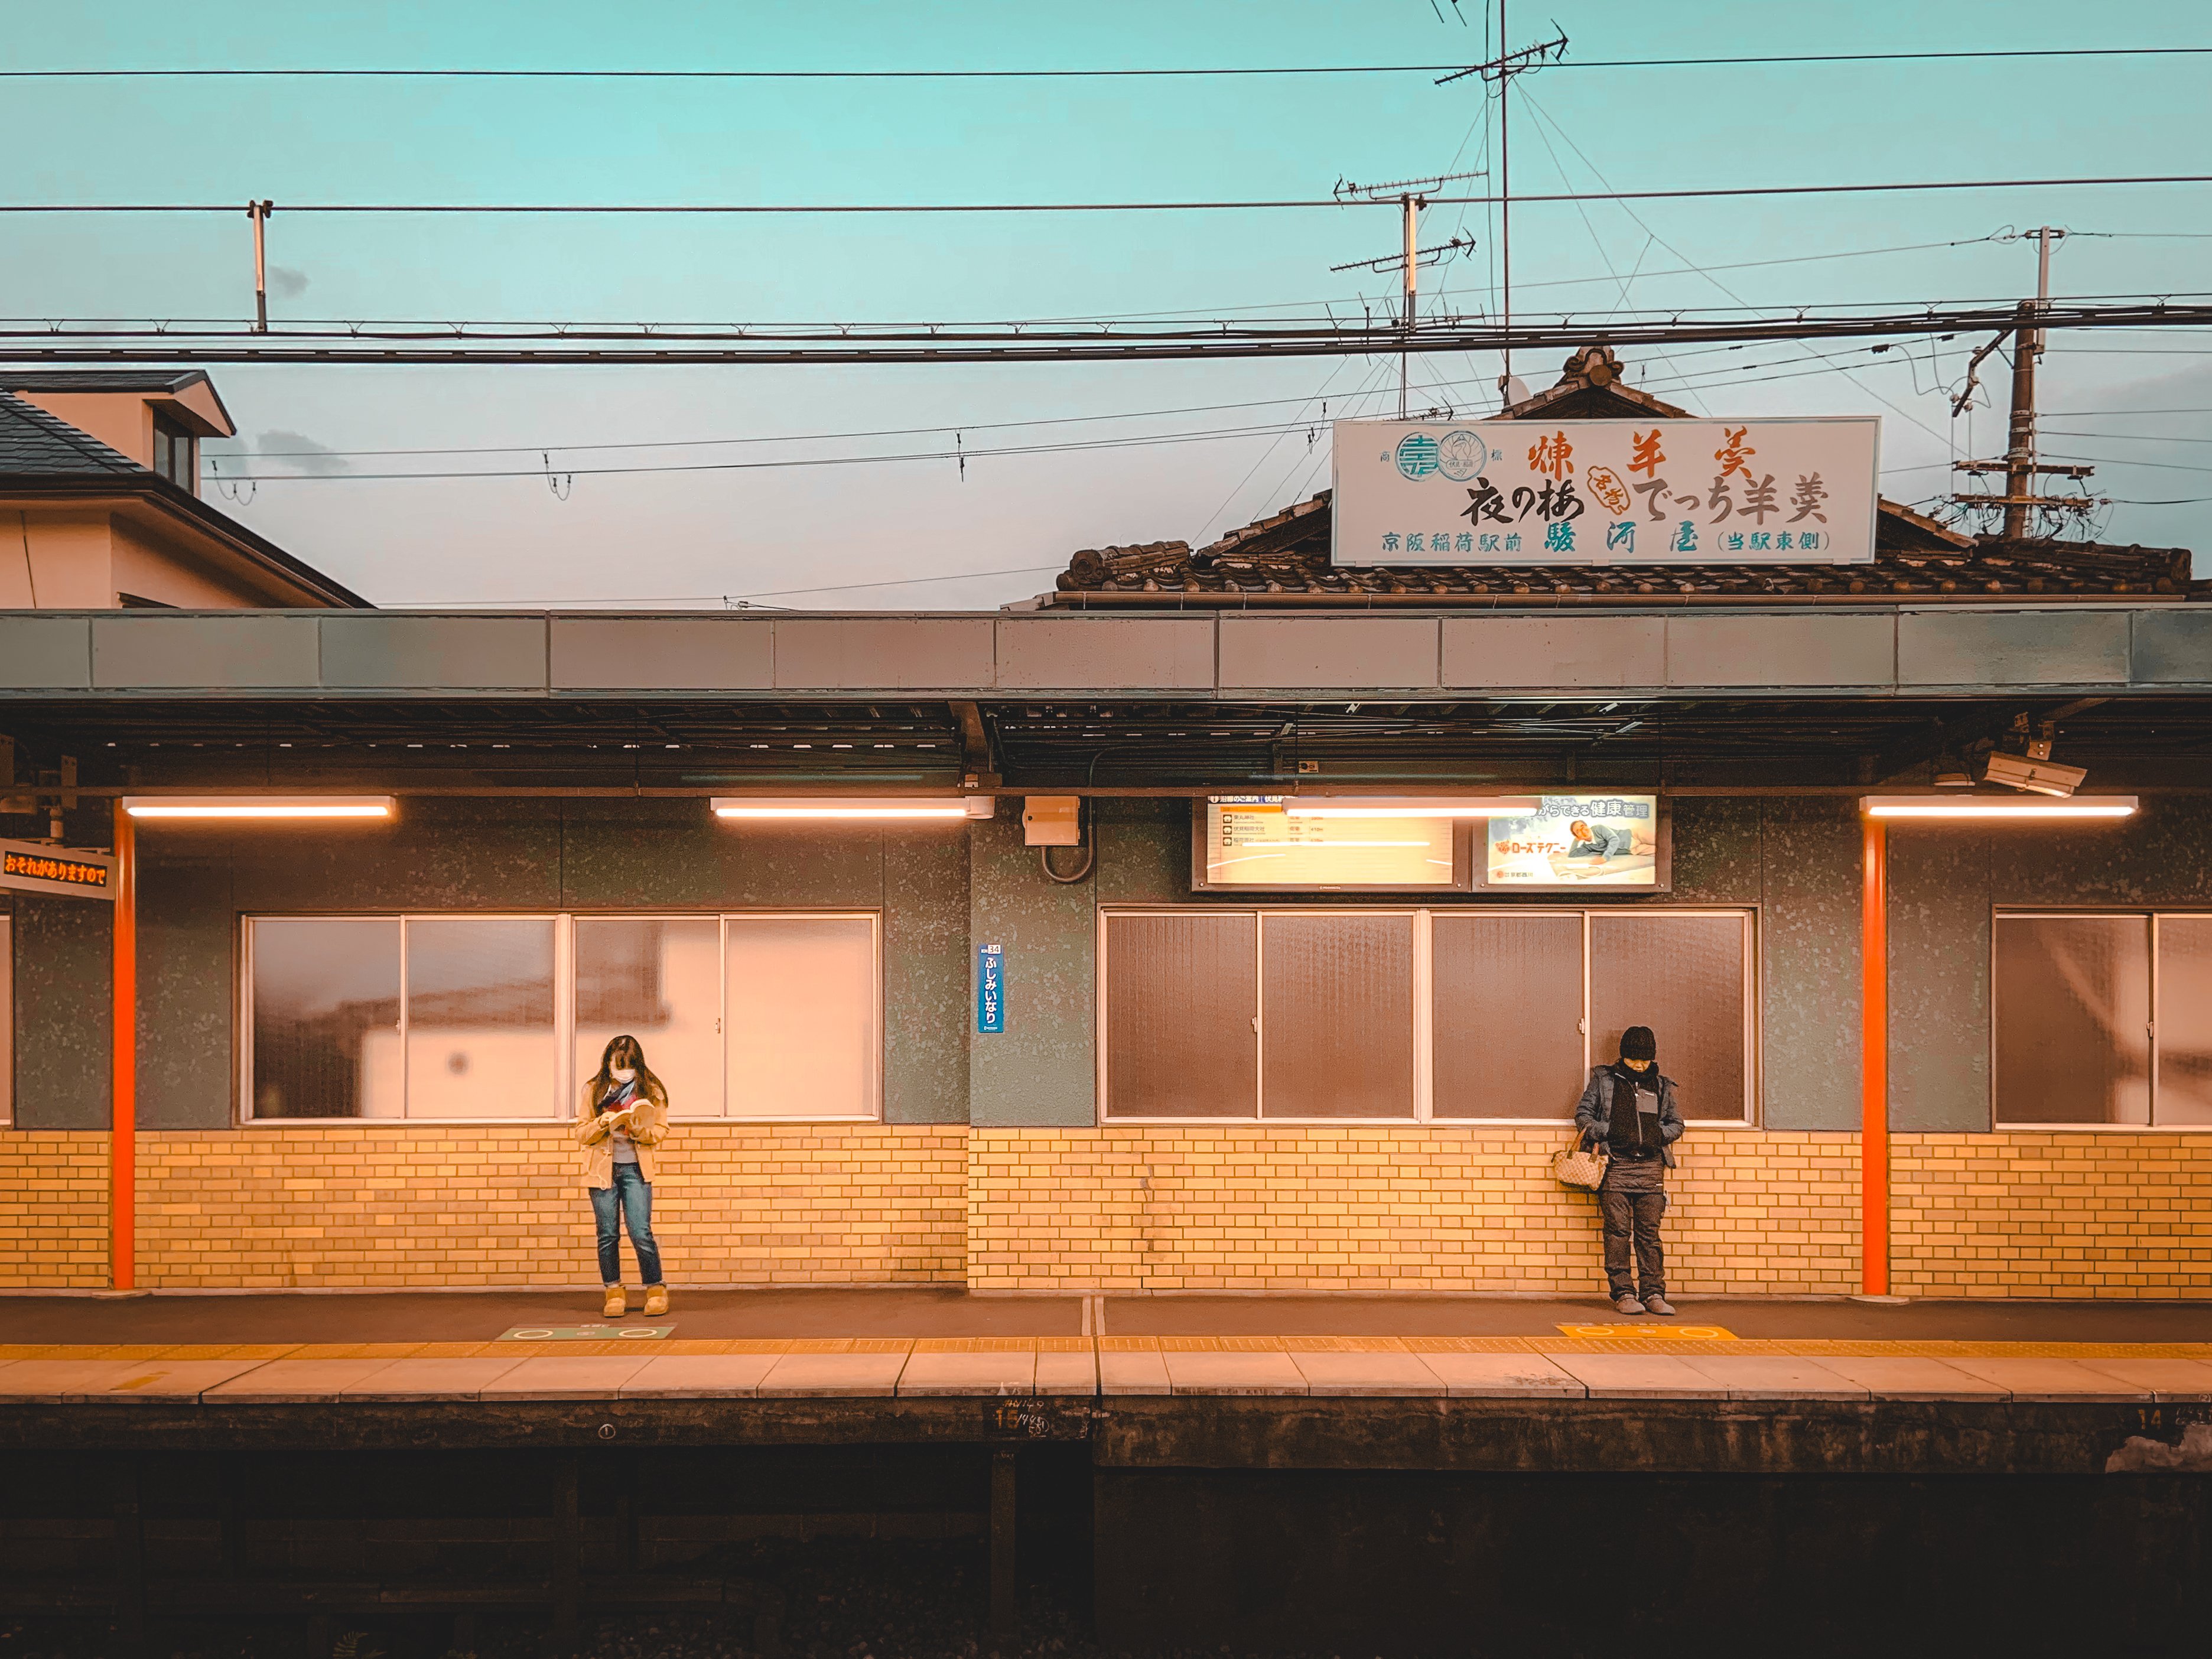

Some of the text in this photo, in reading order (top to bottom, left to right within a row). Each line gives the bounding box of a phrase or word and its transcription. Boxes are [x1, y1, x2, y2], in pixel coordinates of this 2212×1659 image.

[1632, 471, 1828, 525] でっち羊羹
[1382, 532, 1523, 552] 京阪稲荷駅前
[985, 958, 997, 1024] ふしみいなり
